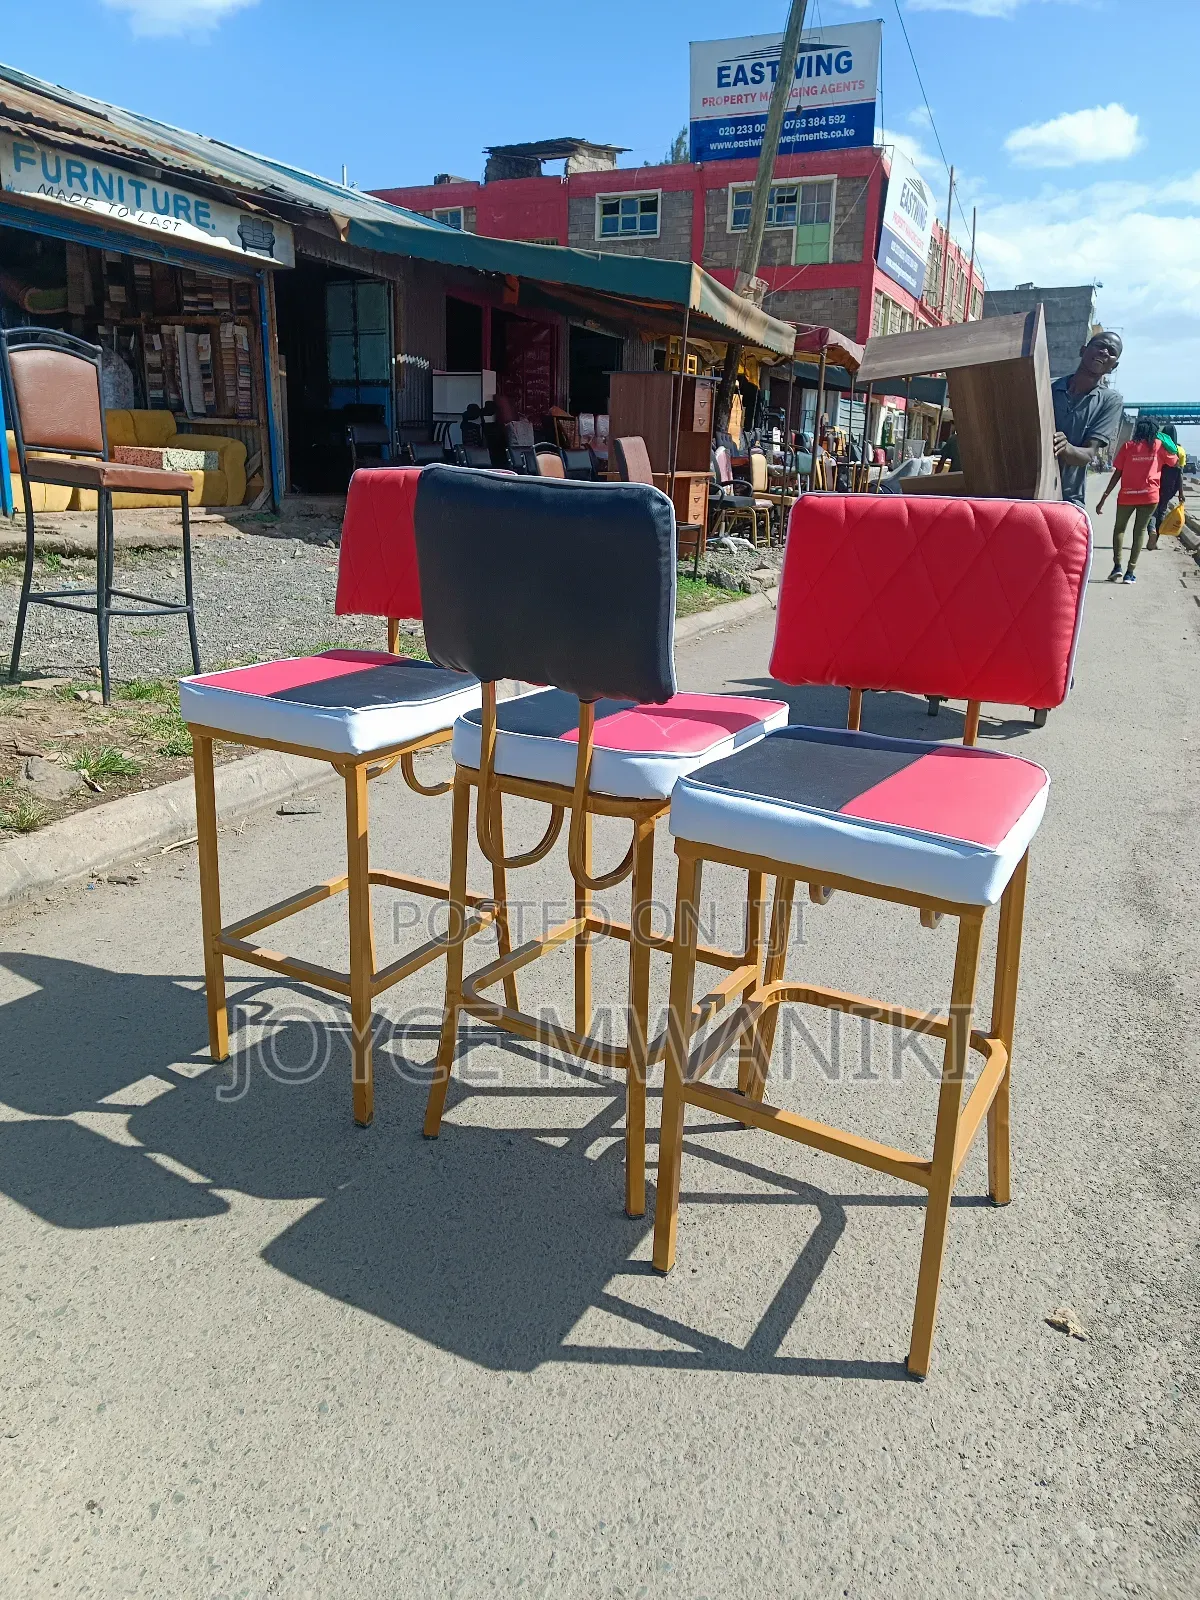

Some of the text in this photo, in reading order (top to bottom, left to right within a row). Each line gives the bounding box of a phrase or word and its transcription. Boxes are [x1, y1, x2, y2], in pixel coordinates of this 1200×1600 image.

[702, 93, 757, 108] PROPERTY
[820, 80, 865, 95] AGENTS
[719, 126, 736, 136] 020
[737, 124, 753, 135] 233
[807, 116, 826, 127] 384
[828, 114, 846, 125] 592
[37, 183, 182, 233] MADE TO LAST
